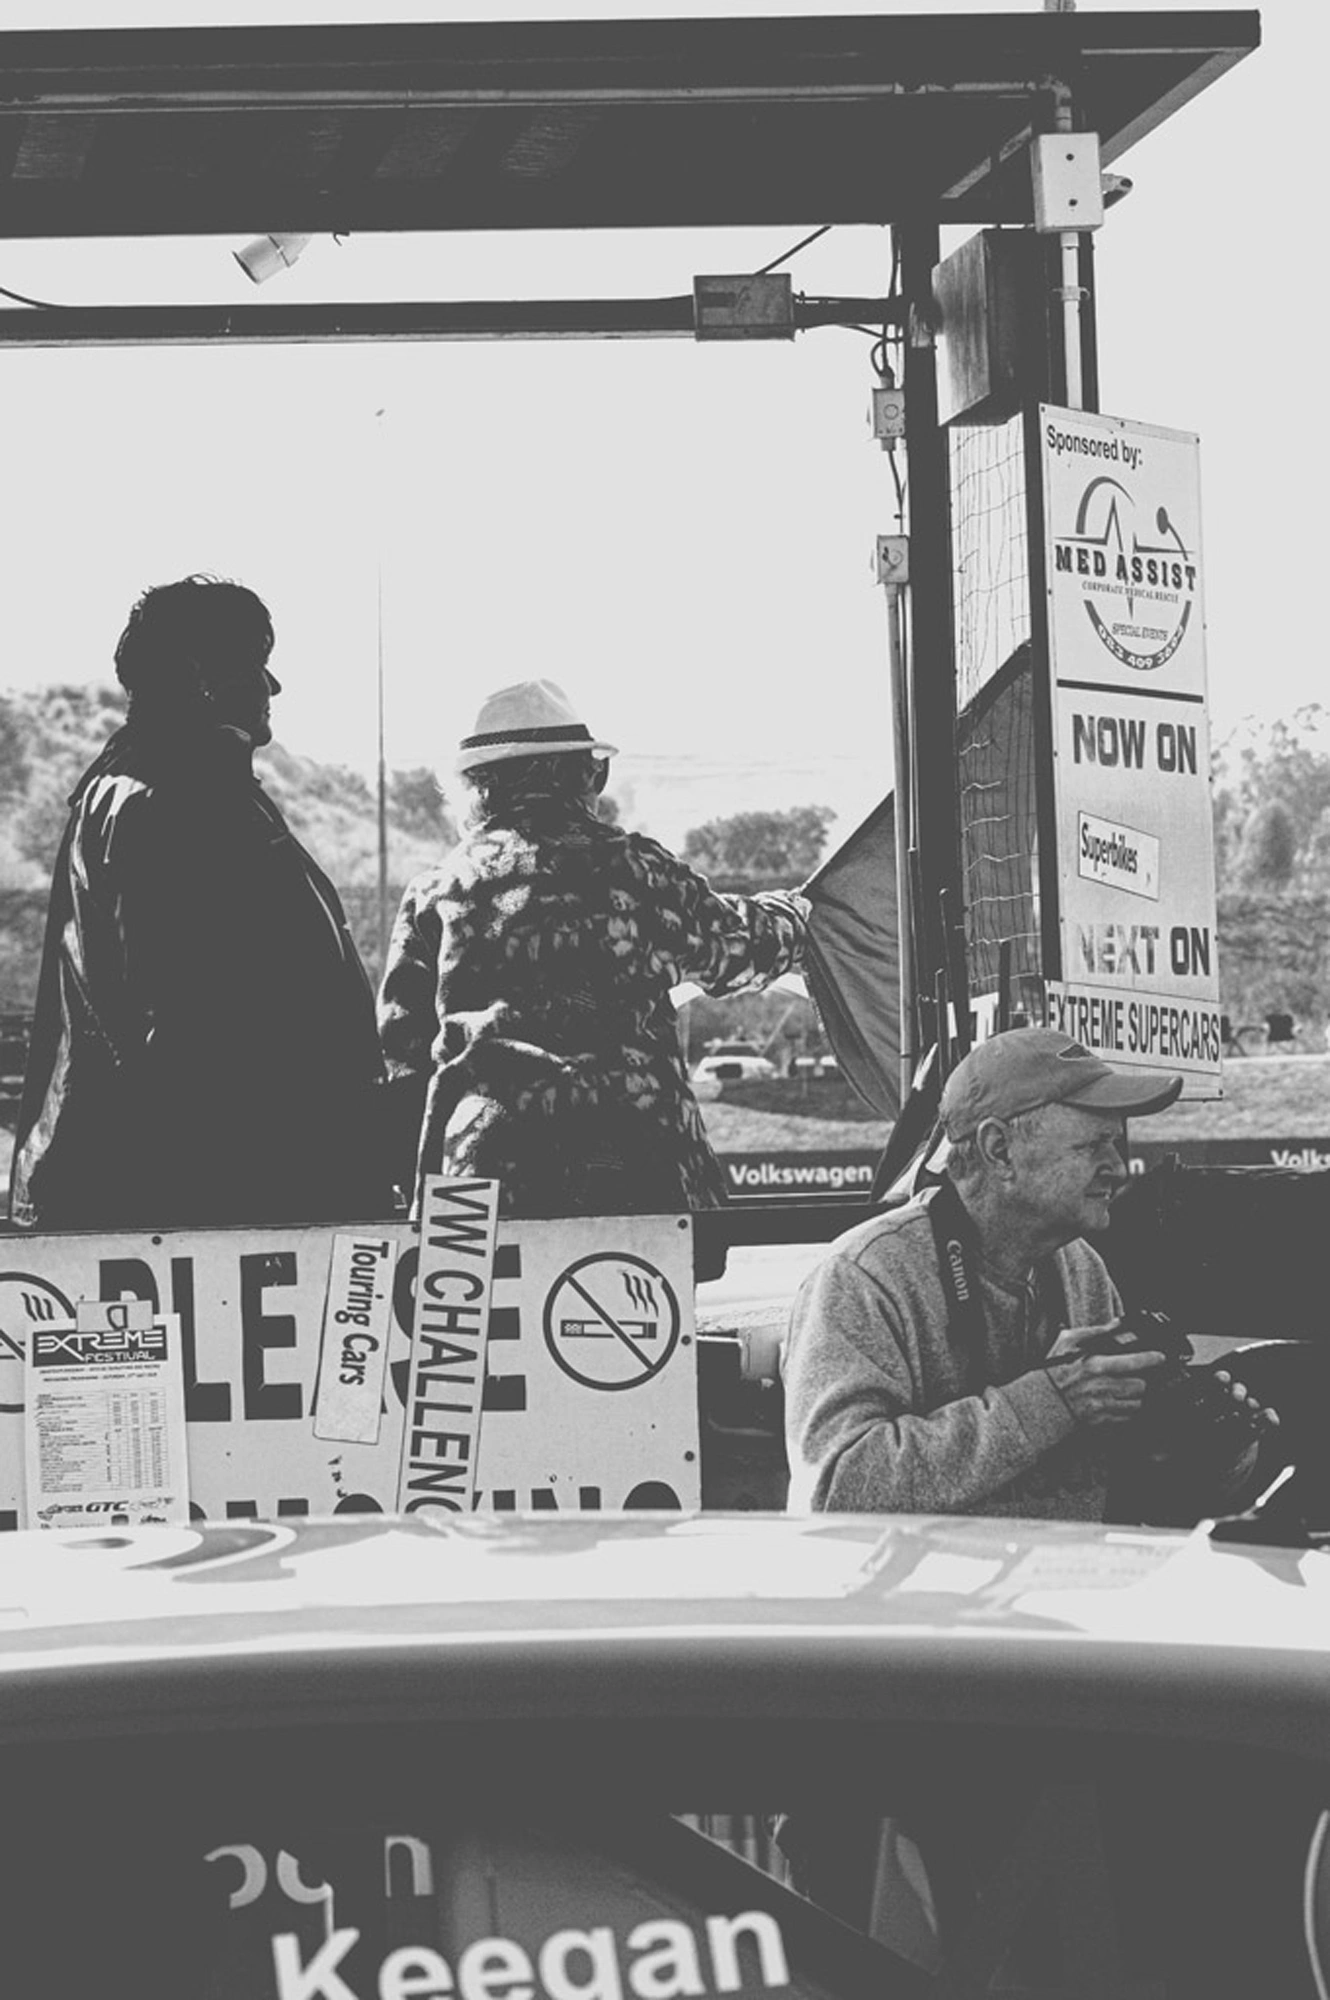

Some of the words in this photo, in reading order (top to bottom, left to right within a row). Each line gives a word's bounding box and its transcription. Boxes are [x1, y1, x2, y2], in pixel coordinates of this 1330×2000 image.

[1047, 424, 1119, 461] Sponsored
[1121, 441, 1143, 470] by:
[1055, 545, 1107, 578] MED
[1116, 553, 1197, 592] ASSIST
[1072, 714, 1146, 770] NOW
[1157, 723, 1197, 775] ON
[1081, 821, 1138, 874] Superbikes
[1077, 923, 1159, 975] NEXT
[1170, 926, 1210, 976] ON
[1048, 993, 1124, 1051] EXTREME
[1129, 1001, 1220, 1063] SUPERCARS
[729, 1163, 873, 1188] Volkswagen
[431, 1181, 491, 1257] VW
[334, 1241, 390, 1326] Touring
[946, 1239, 970, 1301] Canon
[37, 1329, 164, 1361] EXTREME
[83, 1350, 157, 1363] FESTIVAL
[339, 1333, 379, 1385] Cars
[85, 1500, 130, 1513] GTC
[272, 1909, 790, 2000] Keegan
